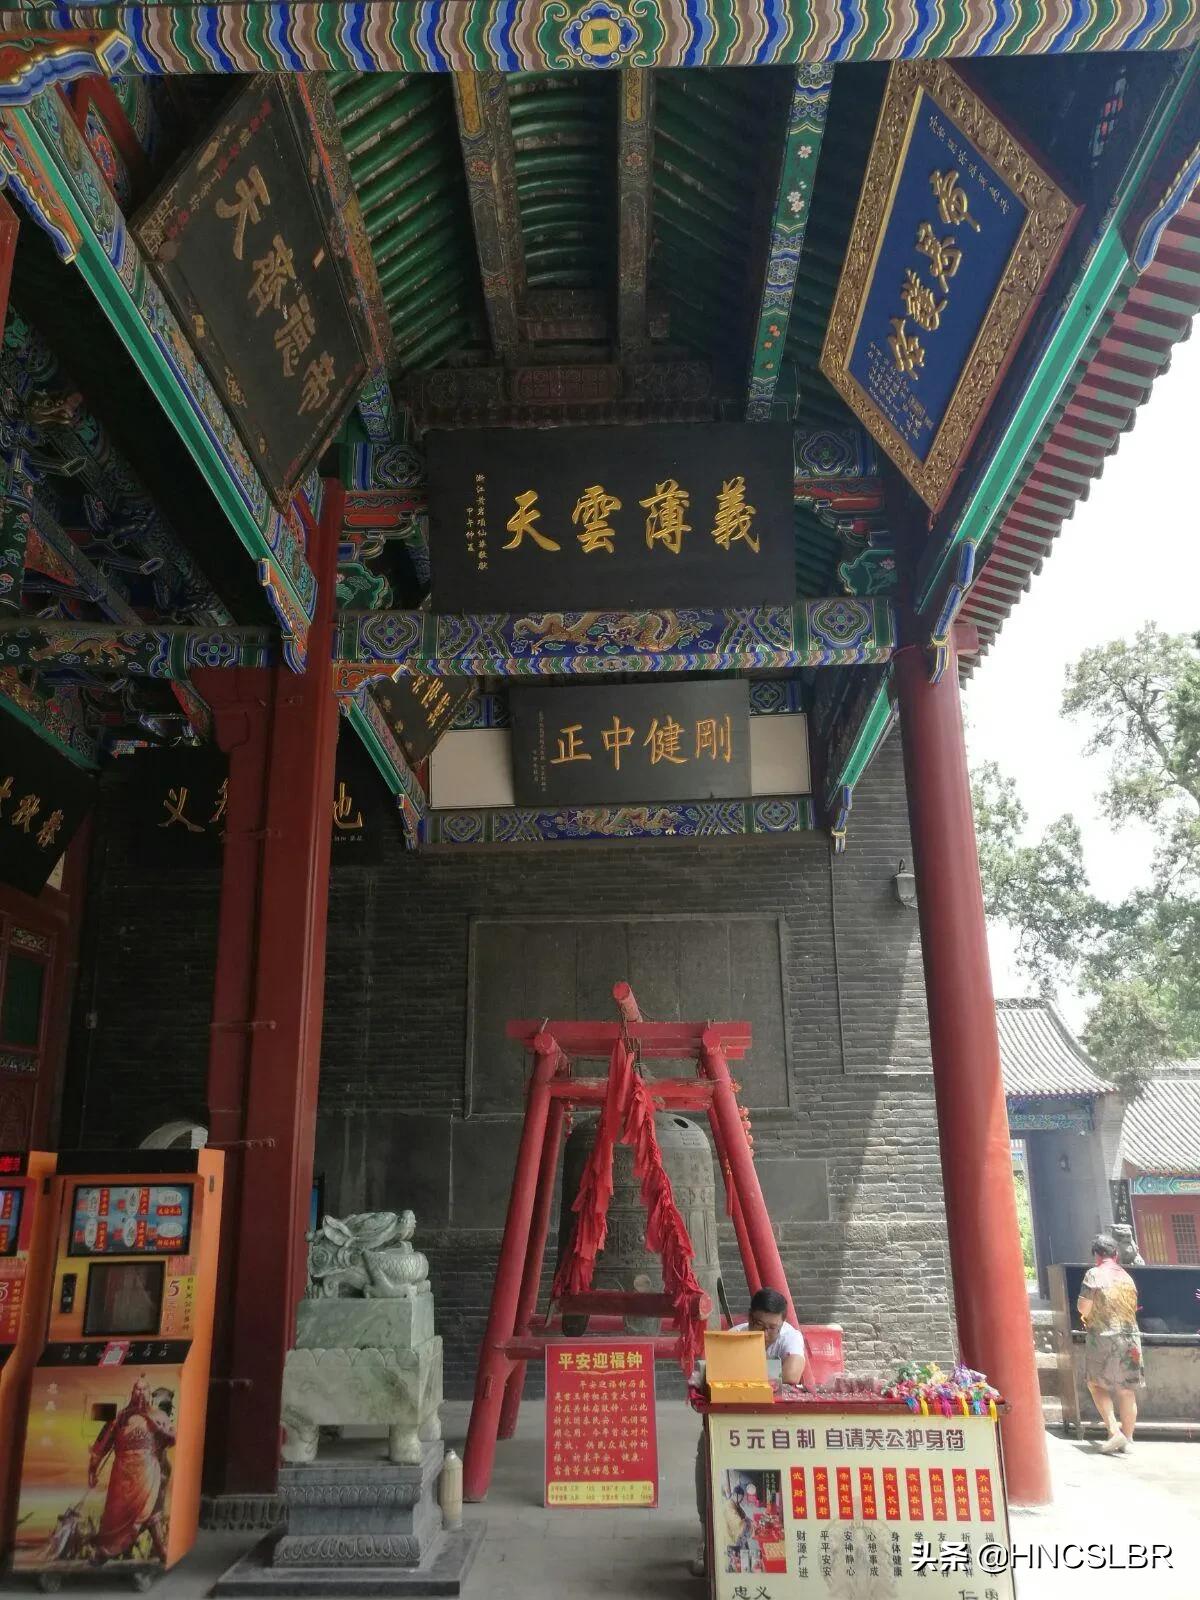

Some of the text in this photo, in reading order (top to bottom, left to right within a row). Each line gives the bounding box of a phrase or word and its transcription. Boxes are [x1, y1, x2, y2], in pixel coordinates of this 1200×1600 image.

[558, 1351, 643, 1371] 平安迎福钟
[825, 1428, 965, 1450] 自请关公护身符
[796, 1530, 808, 1578] 财源广进
[820, 1530, 832, 1577] 平平安安
[843, 1530, 856, 1577] 安神静心
[867, 1531, 879, 1577] 心想事成
[891, 1531, 903, 1577] 身体健康
